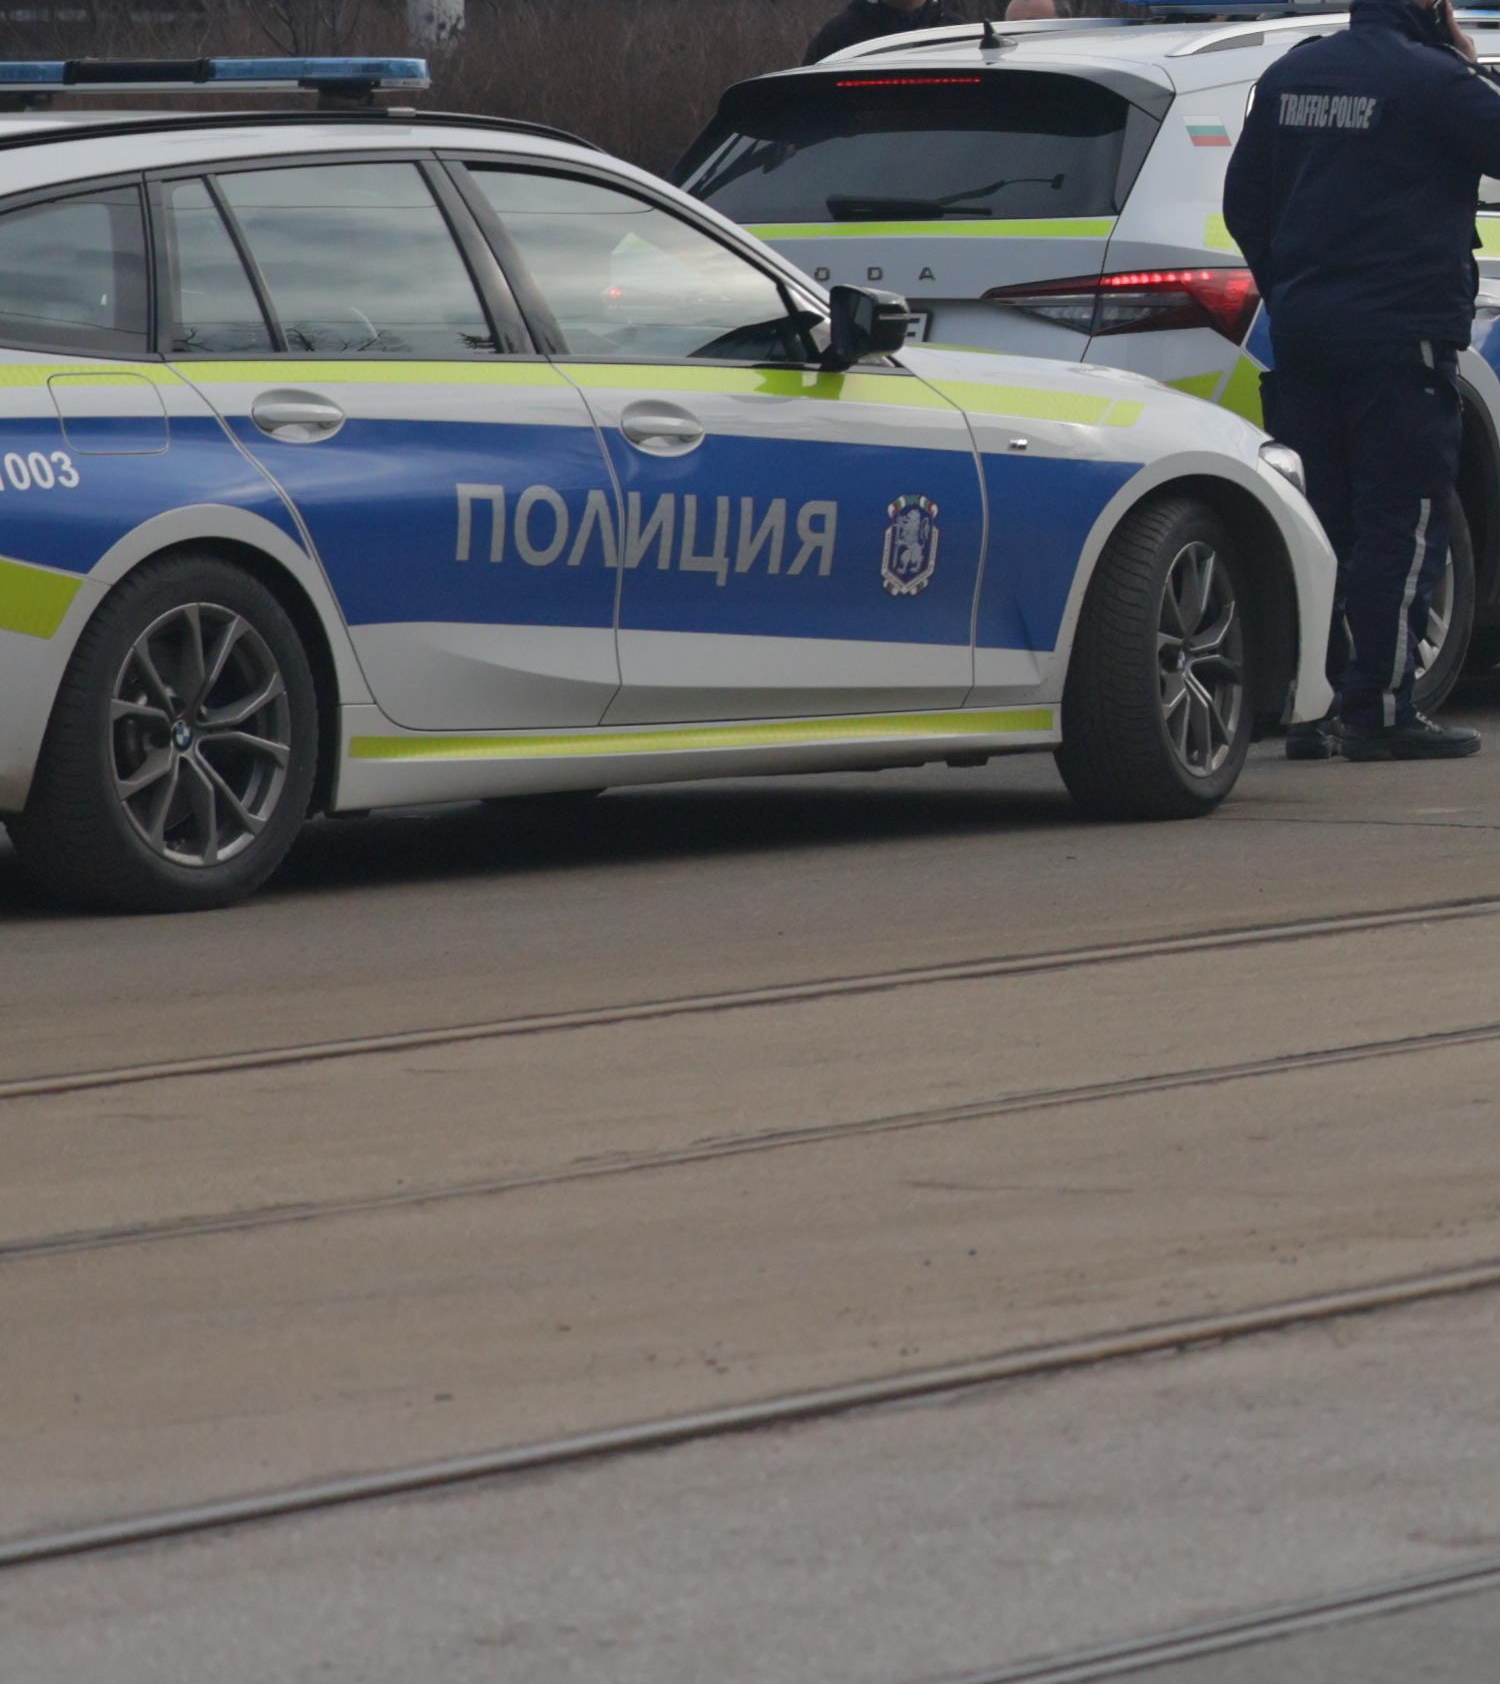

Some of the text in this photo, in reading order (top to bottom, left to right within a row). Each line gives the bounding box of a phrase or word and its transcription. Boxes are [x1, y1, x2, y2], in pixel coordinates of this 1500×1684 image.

[1279, 93, 1376, 128] TRAFFIC POLICE
[814, 267, 936, 282] ODA
[455, 482, 839, 587] ПОЛИЦИЯ
